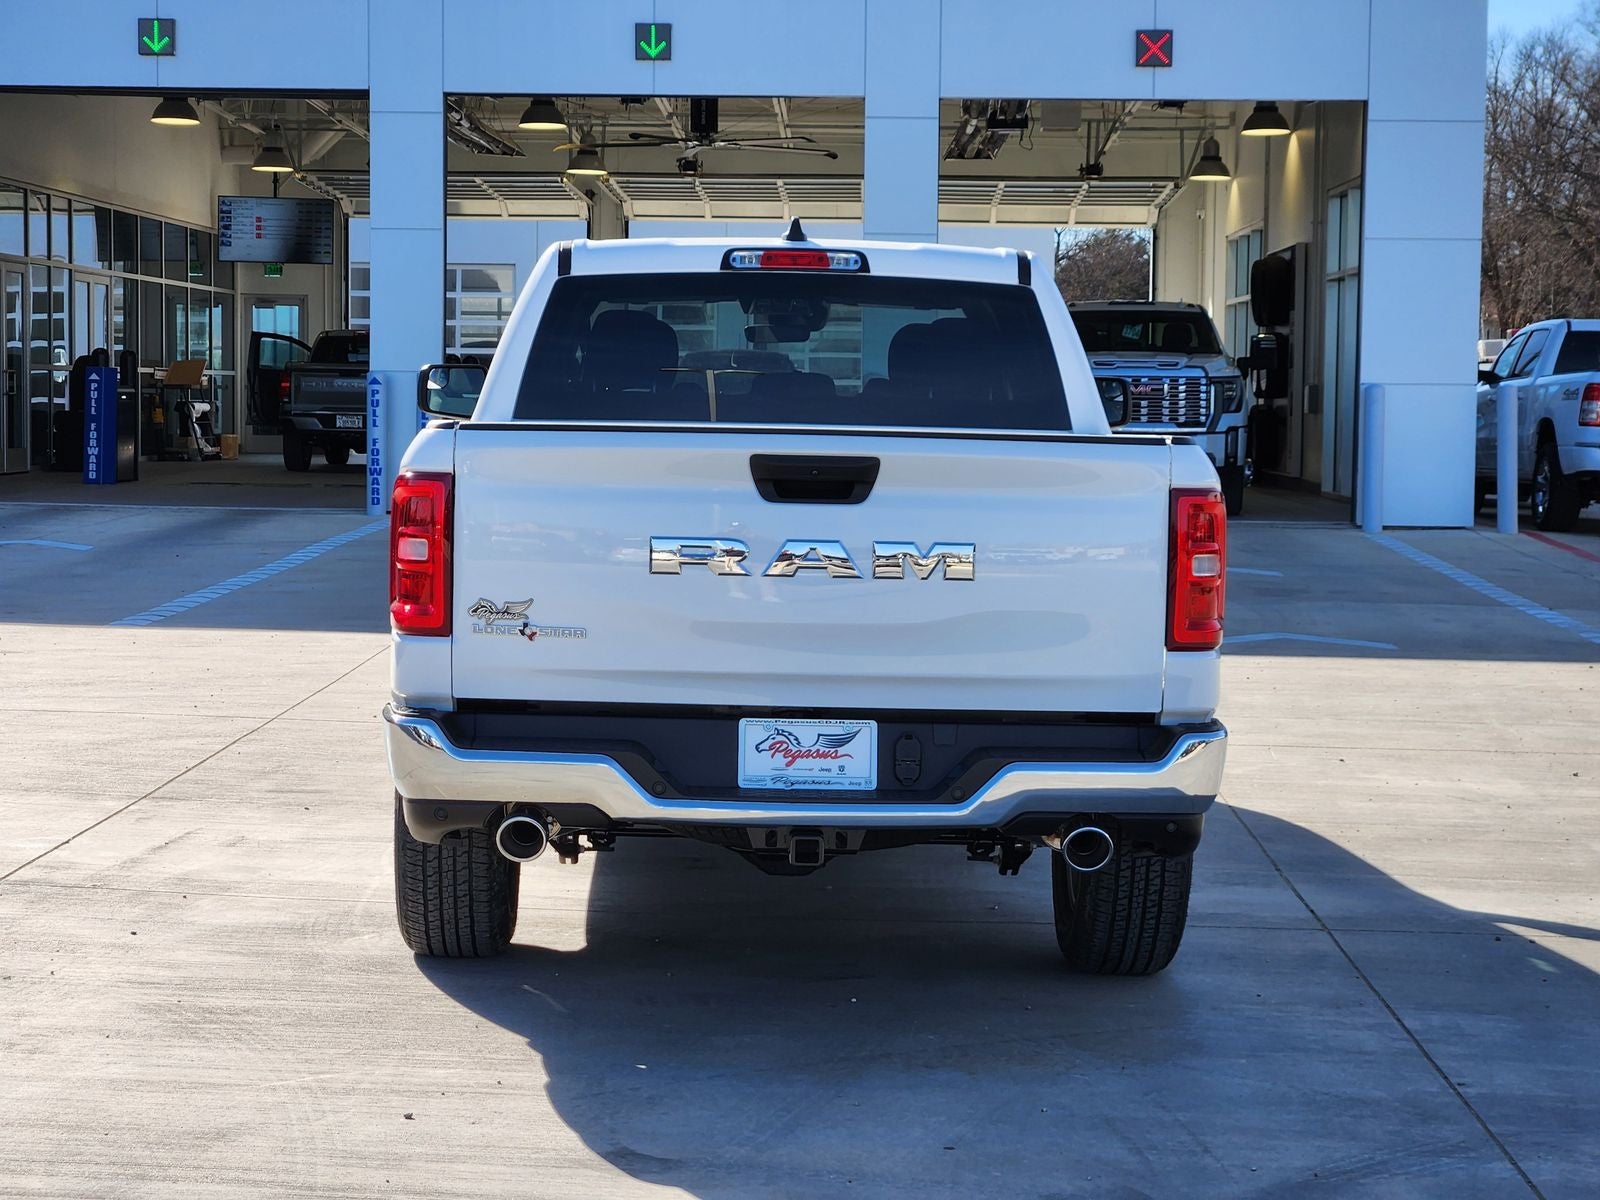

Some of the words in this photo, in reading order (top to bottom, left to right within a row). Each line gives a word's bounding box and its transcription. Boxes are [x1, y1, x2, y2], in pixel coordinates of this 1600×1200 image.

[90, 382, 98, 415] PULL
[370, 389, 380, 428] PULL
[87, 423, 99, 479] FORWARD
[368, 438, 382, 505] FORWARD
[649, 536, 976, 580] RAM
[472, 624, 518, 636] LONE
[538, 627, 587, 638] STAR
[477, 607, 518, 625] Pegasus
[768, 740, 854, 767] Pegasus
